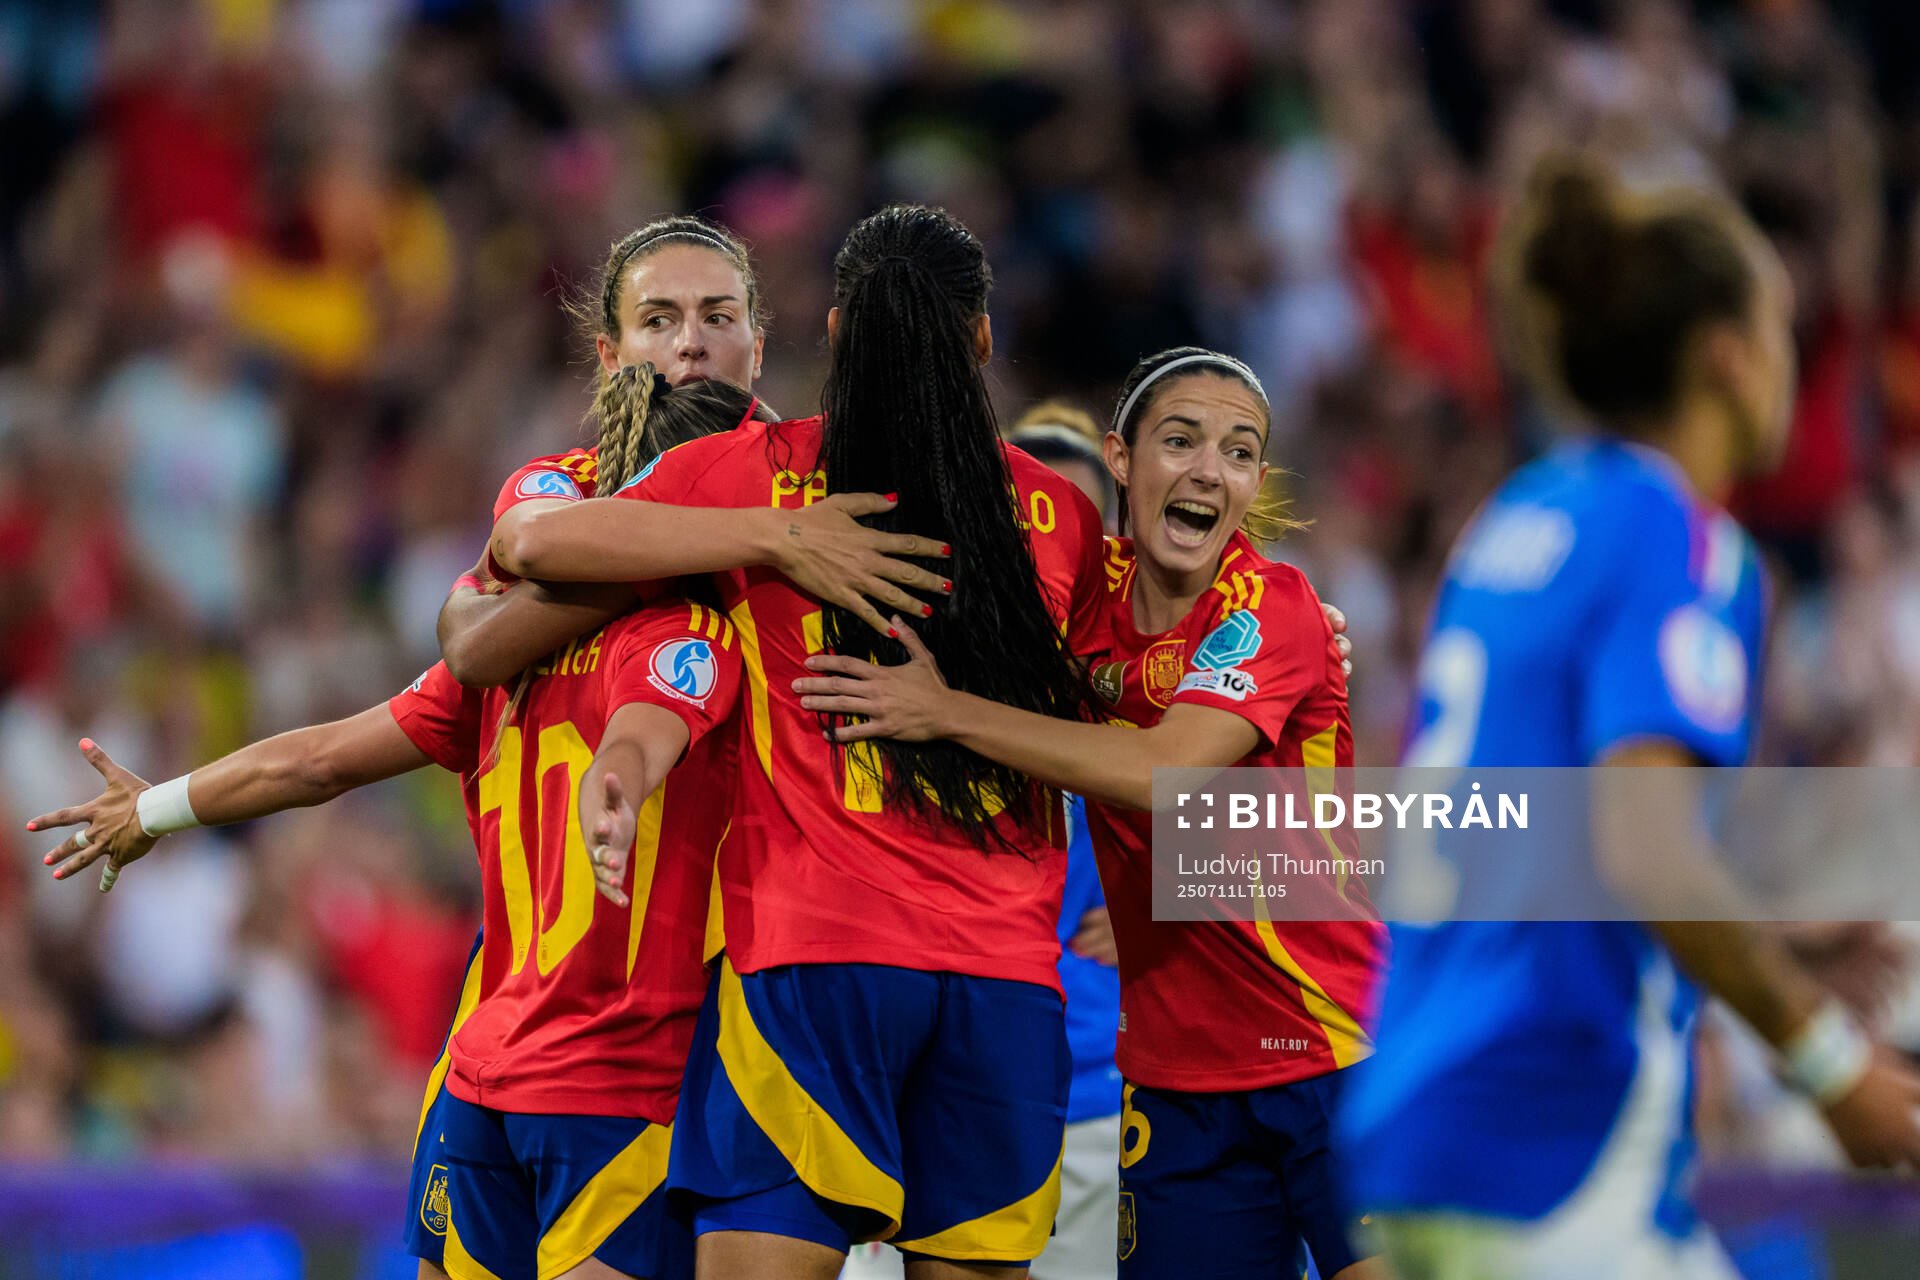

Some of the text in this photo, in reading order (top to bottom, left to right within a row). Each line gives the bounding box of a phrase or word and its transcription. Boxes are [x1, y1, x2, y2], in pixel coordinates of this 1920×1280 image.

[478, 720, 597, 977] 10
[1260, 1037, 1309, 1051] HEAT.RDY
[1120, 1081, 1152, 1170] 6
